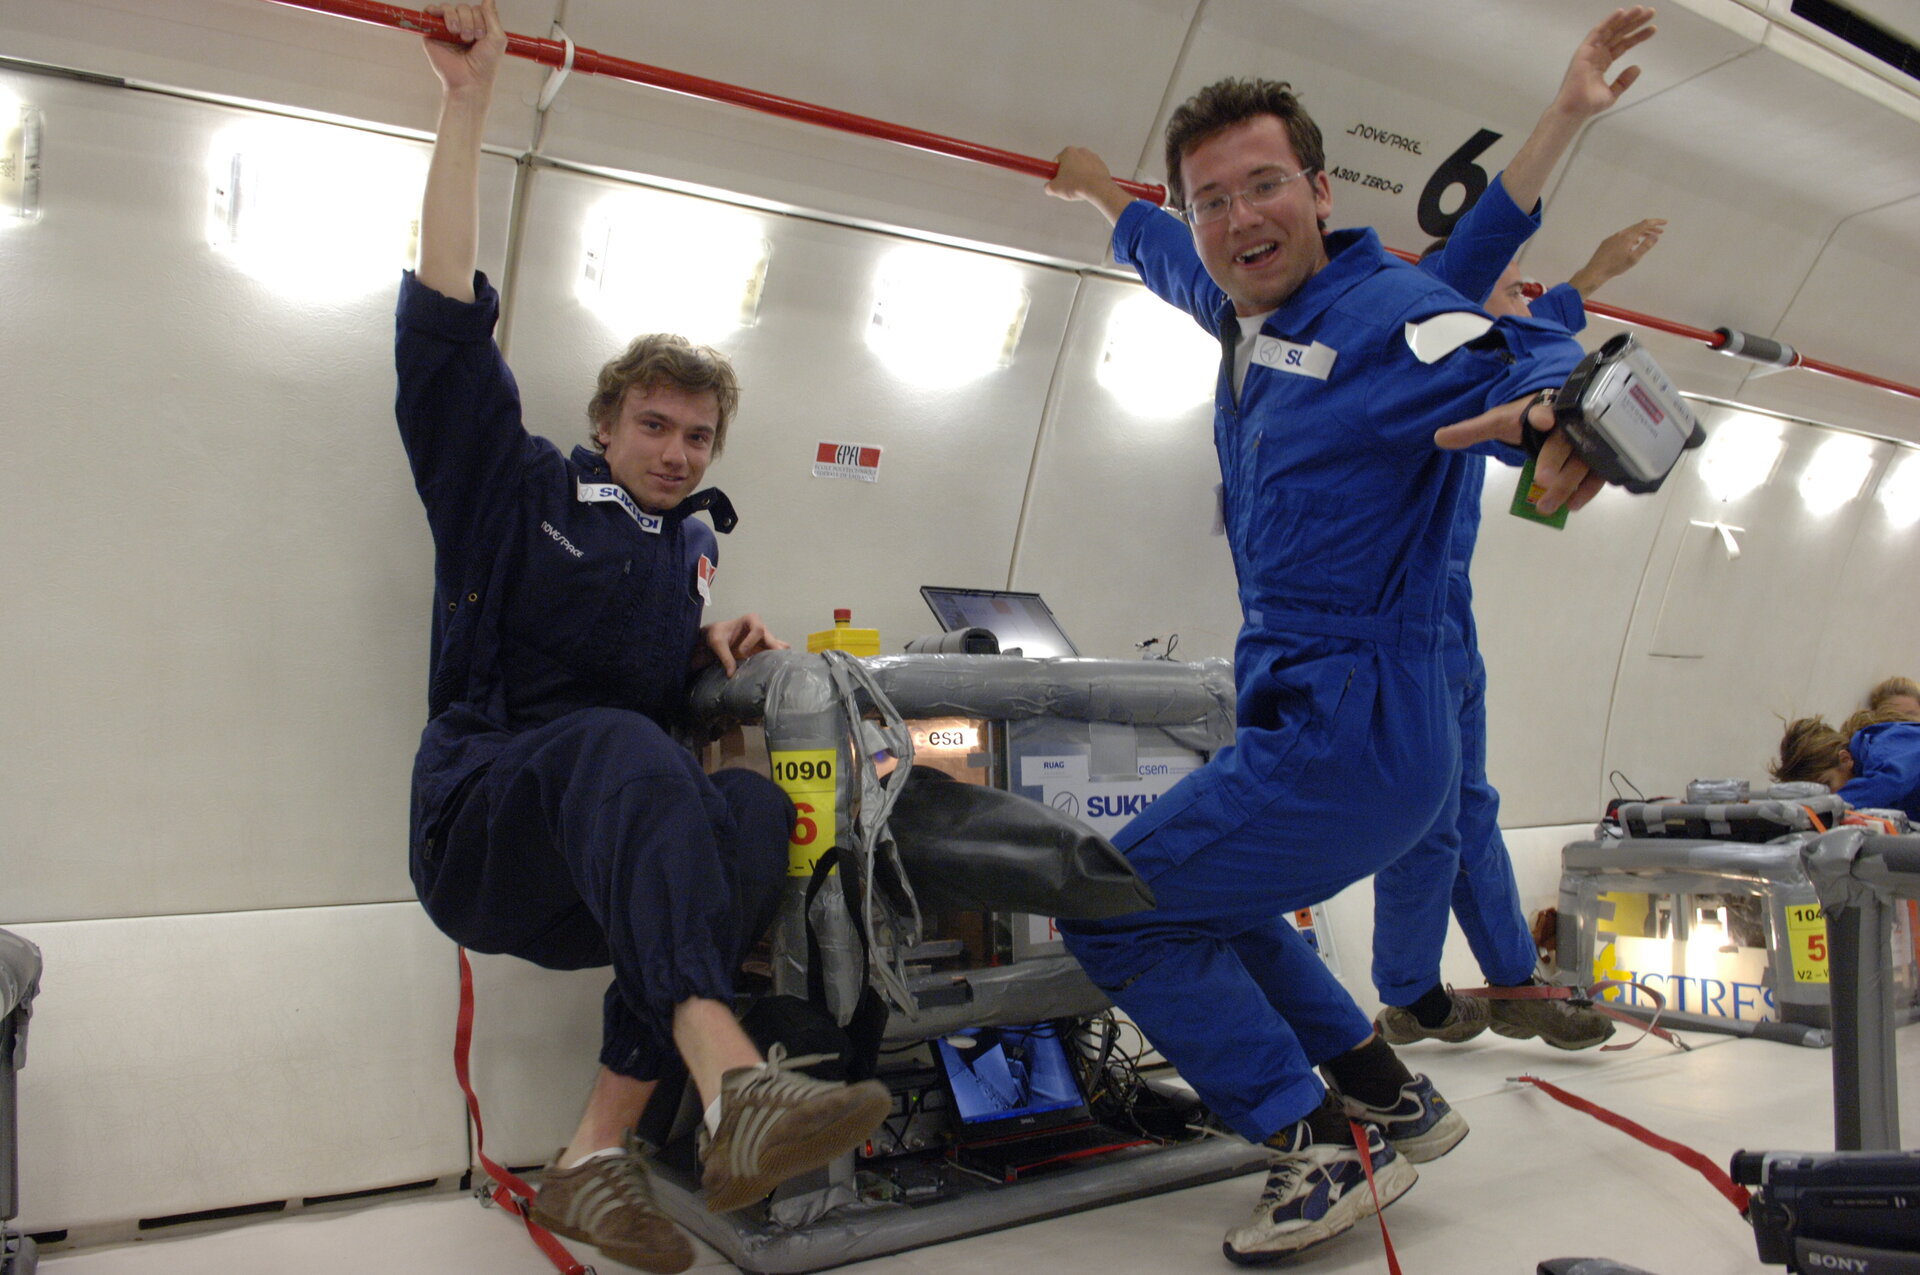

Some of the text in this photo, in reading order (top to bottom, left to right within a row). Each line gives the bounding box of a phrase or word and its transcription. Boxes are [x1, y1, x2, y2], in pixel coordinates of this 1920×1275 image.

[1329, 166, 1403, 194] A300 ZERO-G
[1417, 128, 1503, 238] 6
[836, 444, 859, 466] EPFL
[600, 487, 659, 529] SUKHOI
[541, 521, 584, 558] NOVESPACE
[929, 731, 964, 746] esa
[775, 761, 832, 781] 1090
[1043, 761, 1065, 769] RUAG
[1138, 764, 1168, 776] csem
[790, 802, 818, 846] 6
[1807, 934, 1827, 962] 5
[1808, 1252, 1869, 1274] SONY
